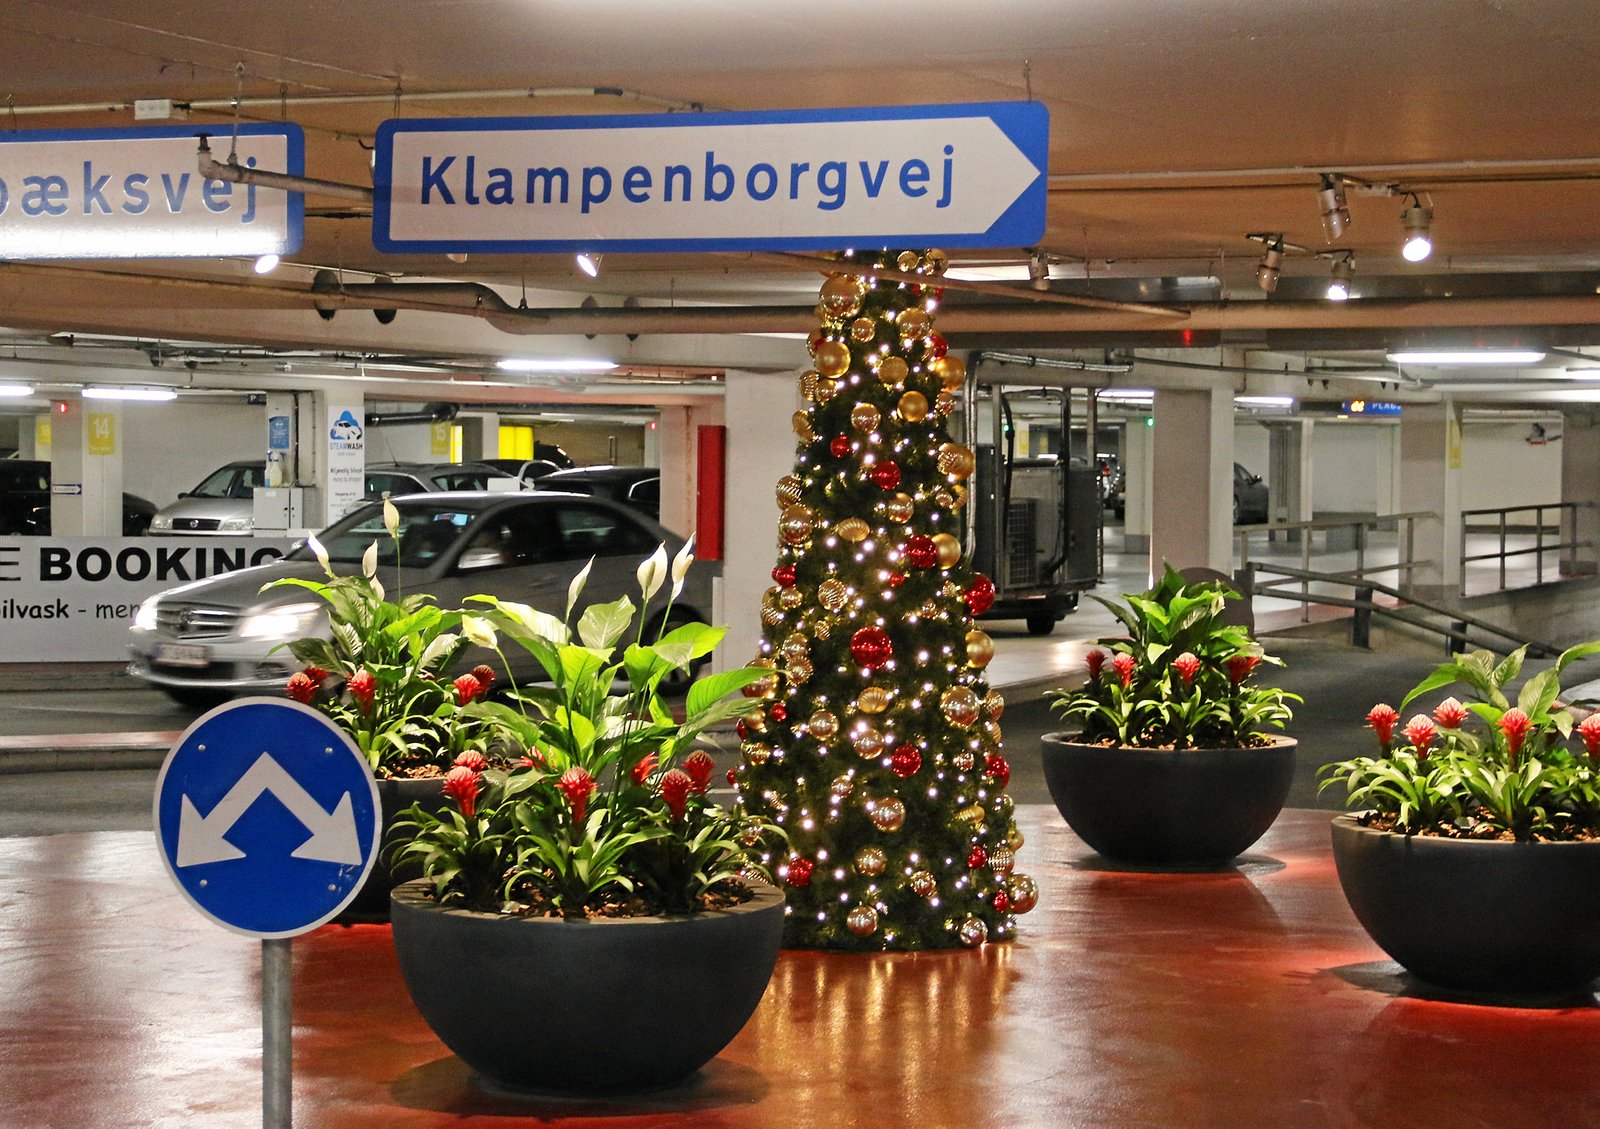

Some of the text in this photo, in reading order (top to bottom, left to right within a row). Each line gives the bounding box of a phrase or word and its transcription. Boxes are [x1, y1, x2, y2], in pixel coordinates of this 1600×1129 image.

[421, 144, 955, 214] Klampenborgvej
[93, 417, 109, 439] 14
[0, 598, 69, 619] ilvask
